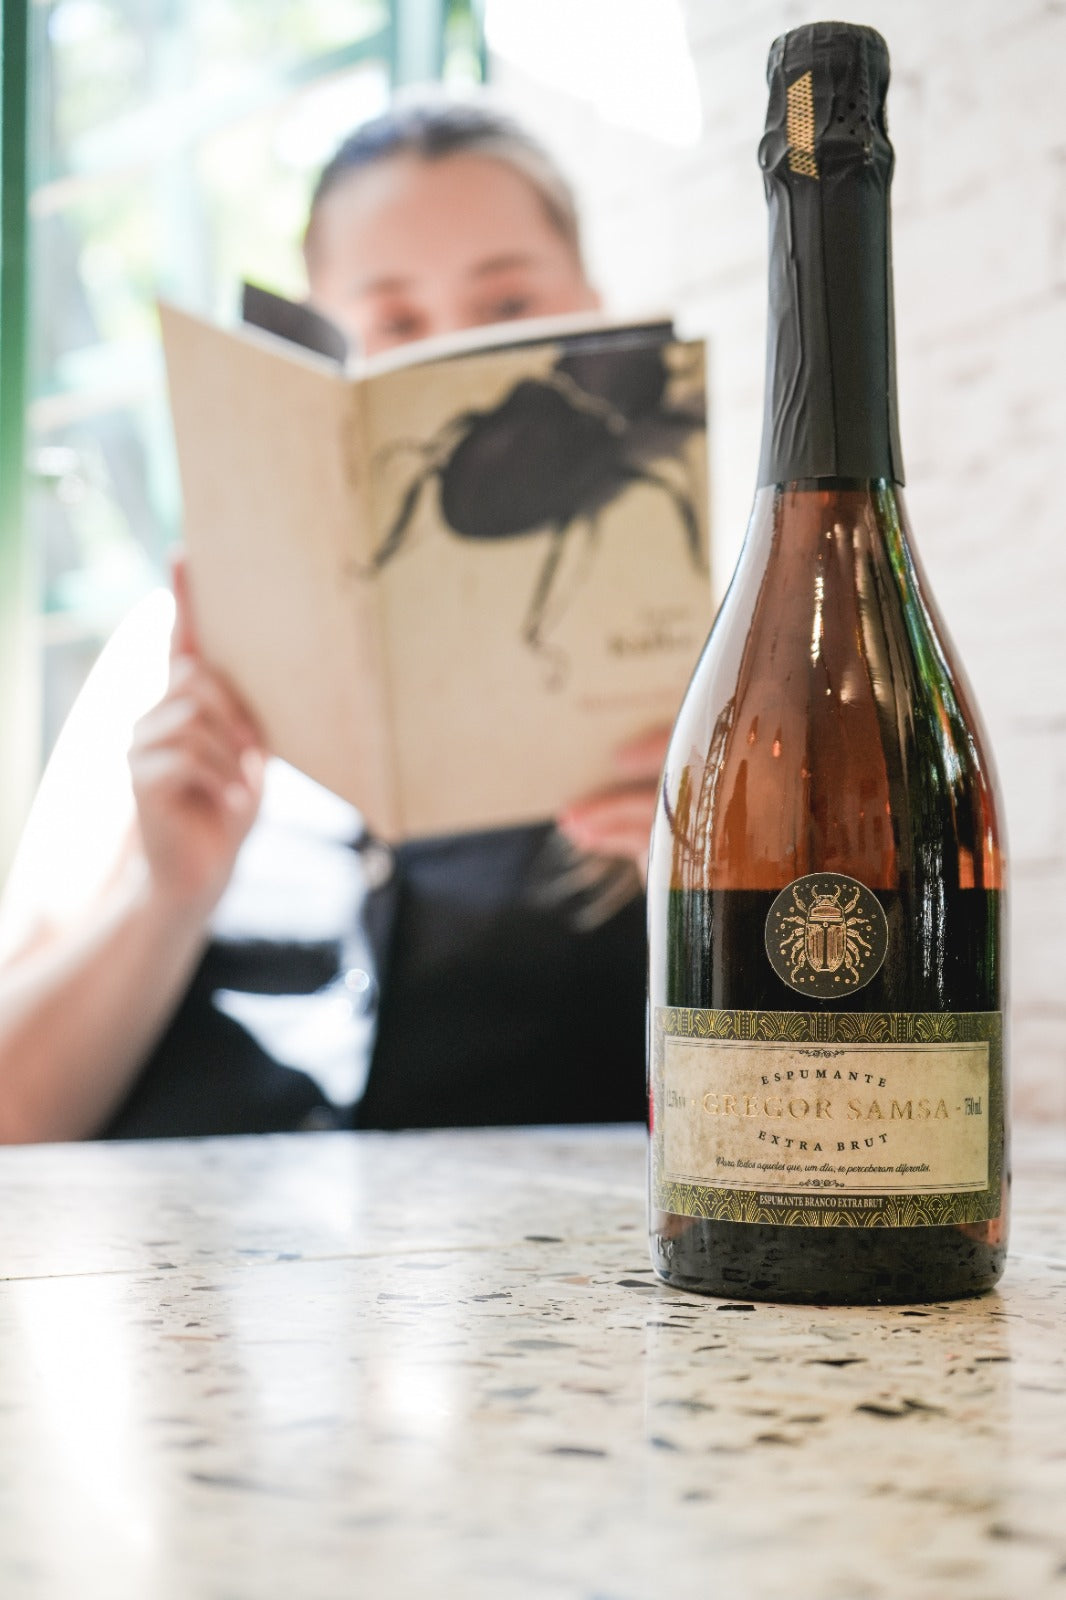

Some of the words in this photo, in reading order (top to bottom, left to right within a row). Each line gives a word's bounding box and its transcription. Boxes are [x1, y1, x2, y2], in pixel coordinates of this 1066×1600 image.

[761, 1069, 887, 1088] ESPUMANTE
[703, 1092, 832, 1121] GREGOR
[846, 1097, 951, 1121] SAMSA
[758, 1130, 823, 1152] EXTRA
[836, 1133, 888, 1152] BRUT
[716, 1156, 735, 1168] Para
[736, 1159, 756, 1169] todos
[757, 1161, 785, 1173] aqueles
[846, 1163, 894, 1175] perceberam
[759, 1194, 805, 1207] ESPUMANTE
[805, 1196, 837, 1208] BRANCO
[838, 1198, 863, 1208] EXTRA
[863, 1198, 884, 1209] BRUT
